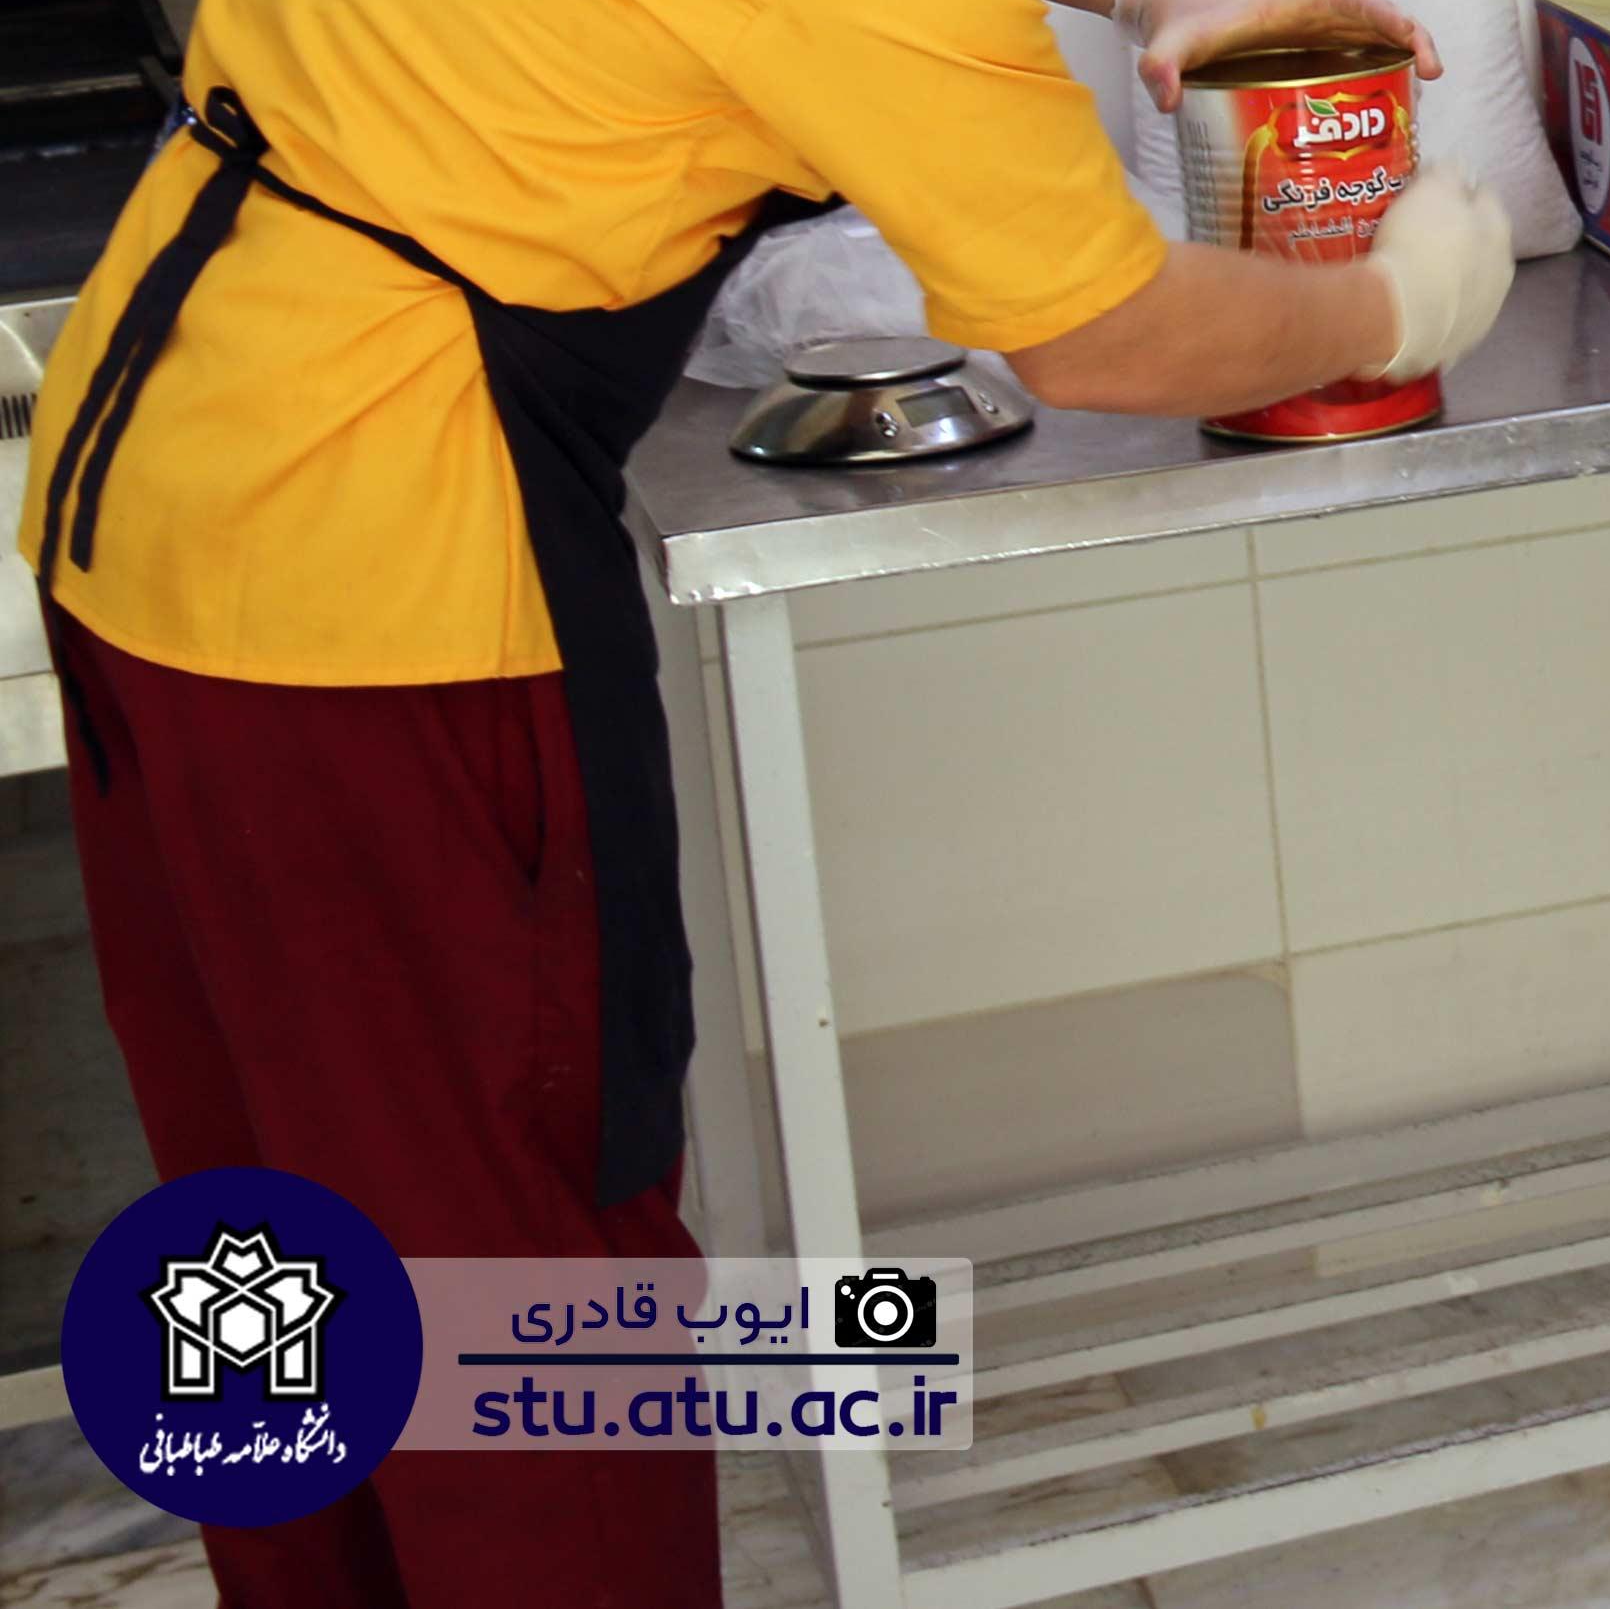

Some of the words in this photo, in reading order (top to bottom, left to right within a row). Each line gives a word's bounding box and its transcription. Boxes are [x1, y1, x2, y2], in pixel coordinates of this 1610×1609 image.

[1293, 107, 1386, 148] دادفر
[1263, 178, 1332, 212] فرنگی
[1335, 166, 1387, 205] گوجه
